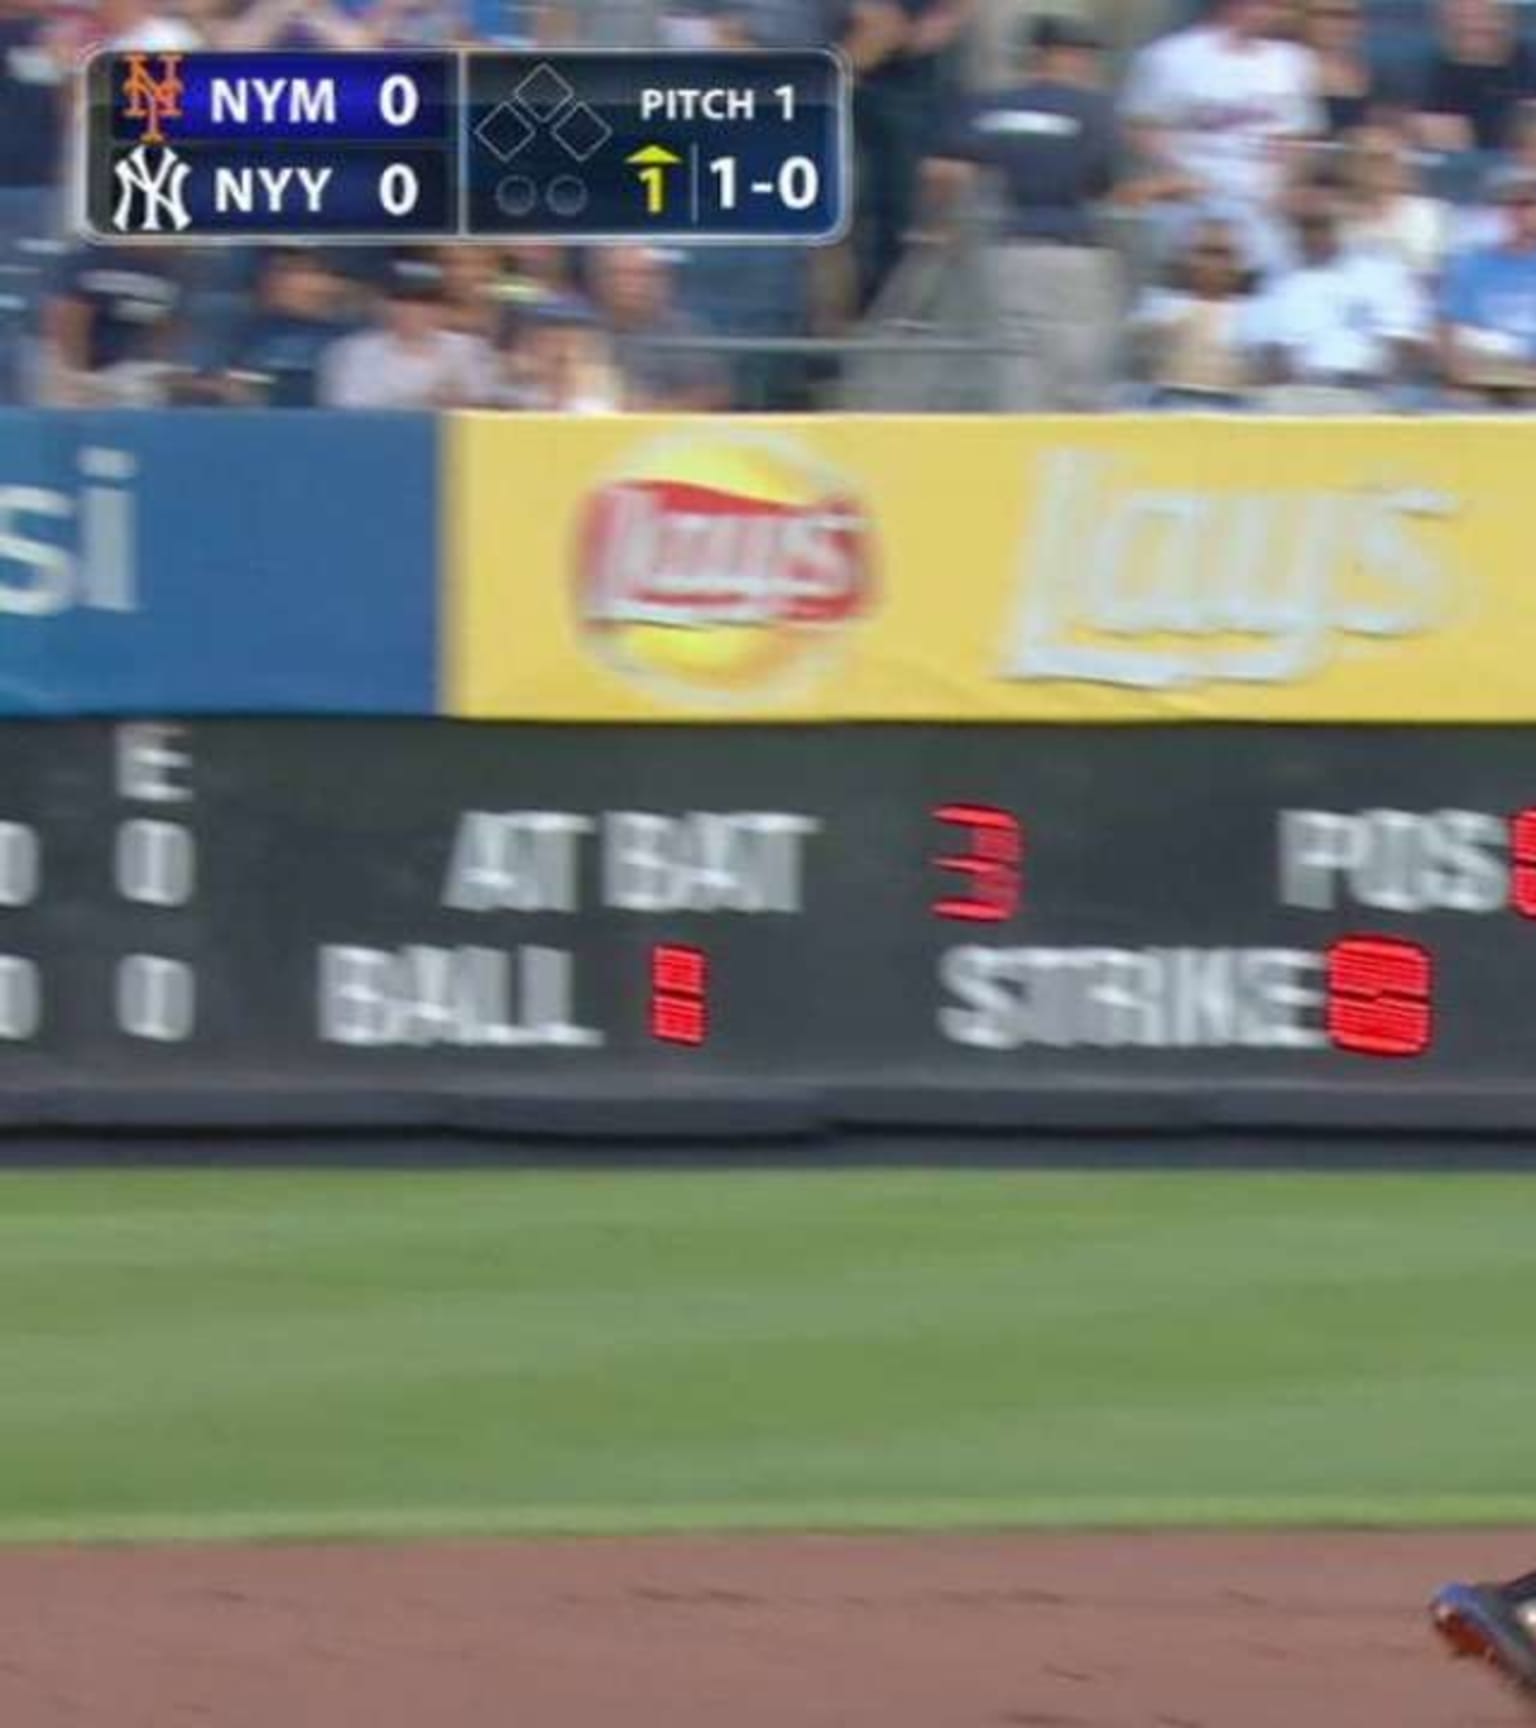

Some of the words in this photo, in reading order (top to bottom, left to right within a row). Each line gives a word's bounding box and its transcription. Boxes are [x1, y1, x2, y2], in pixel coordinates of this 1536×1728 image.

[116, 722, 192, 798] E
[444, 811, 595, 912] AT
[602, 811, 820, 912] BAT
[932, 804, 1023, 921] 3
[1278, 809, 1507, 912] POS
[318, 943, 602, 1047] BALL
[938, 944, 1328, 1048] STRIKE
